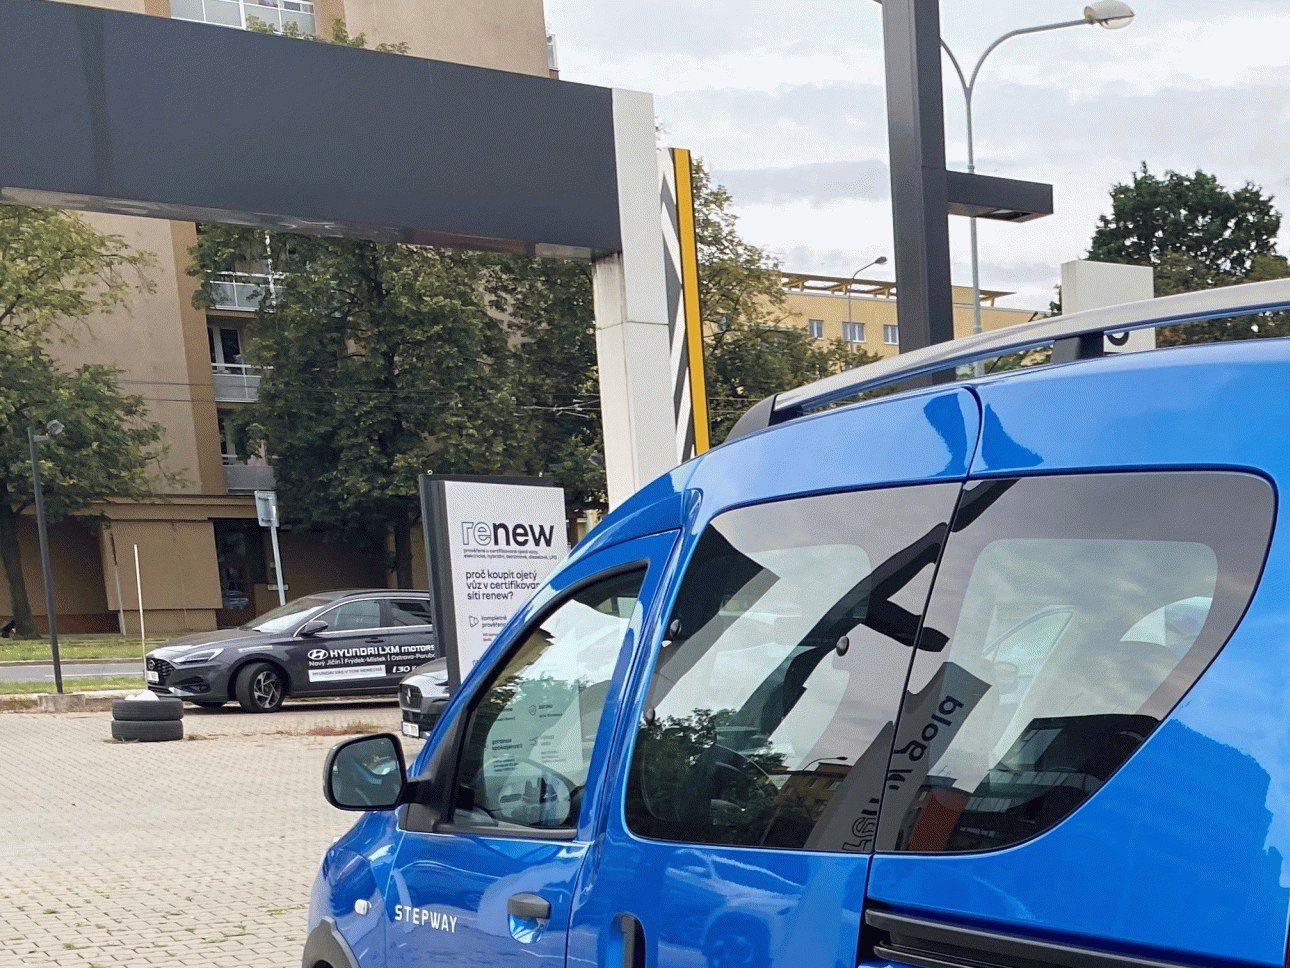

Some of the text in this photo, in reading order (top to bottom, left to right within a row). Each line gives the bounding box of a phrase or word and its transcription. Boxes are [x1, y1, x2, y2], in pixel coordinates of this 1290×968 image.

[461, 521, 555, 547] renew
[465, 569, 537, 581] proč koupit ojetý
[466, 580, 482, 589] vůz
[482, 591, 513, 600] renew?
[379, 645, 400, 655] LXM
[309, 659, 325, 667] Nový
[326, 658, 342, 666] Jičín
[344, 655, 386, 665] Frýdek-Místek
[394, 904, 458, 933] STEPWAY
